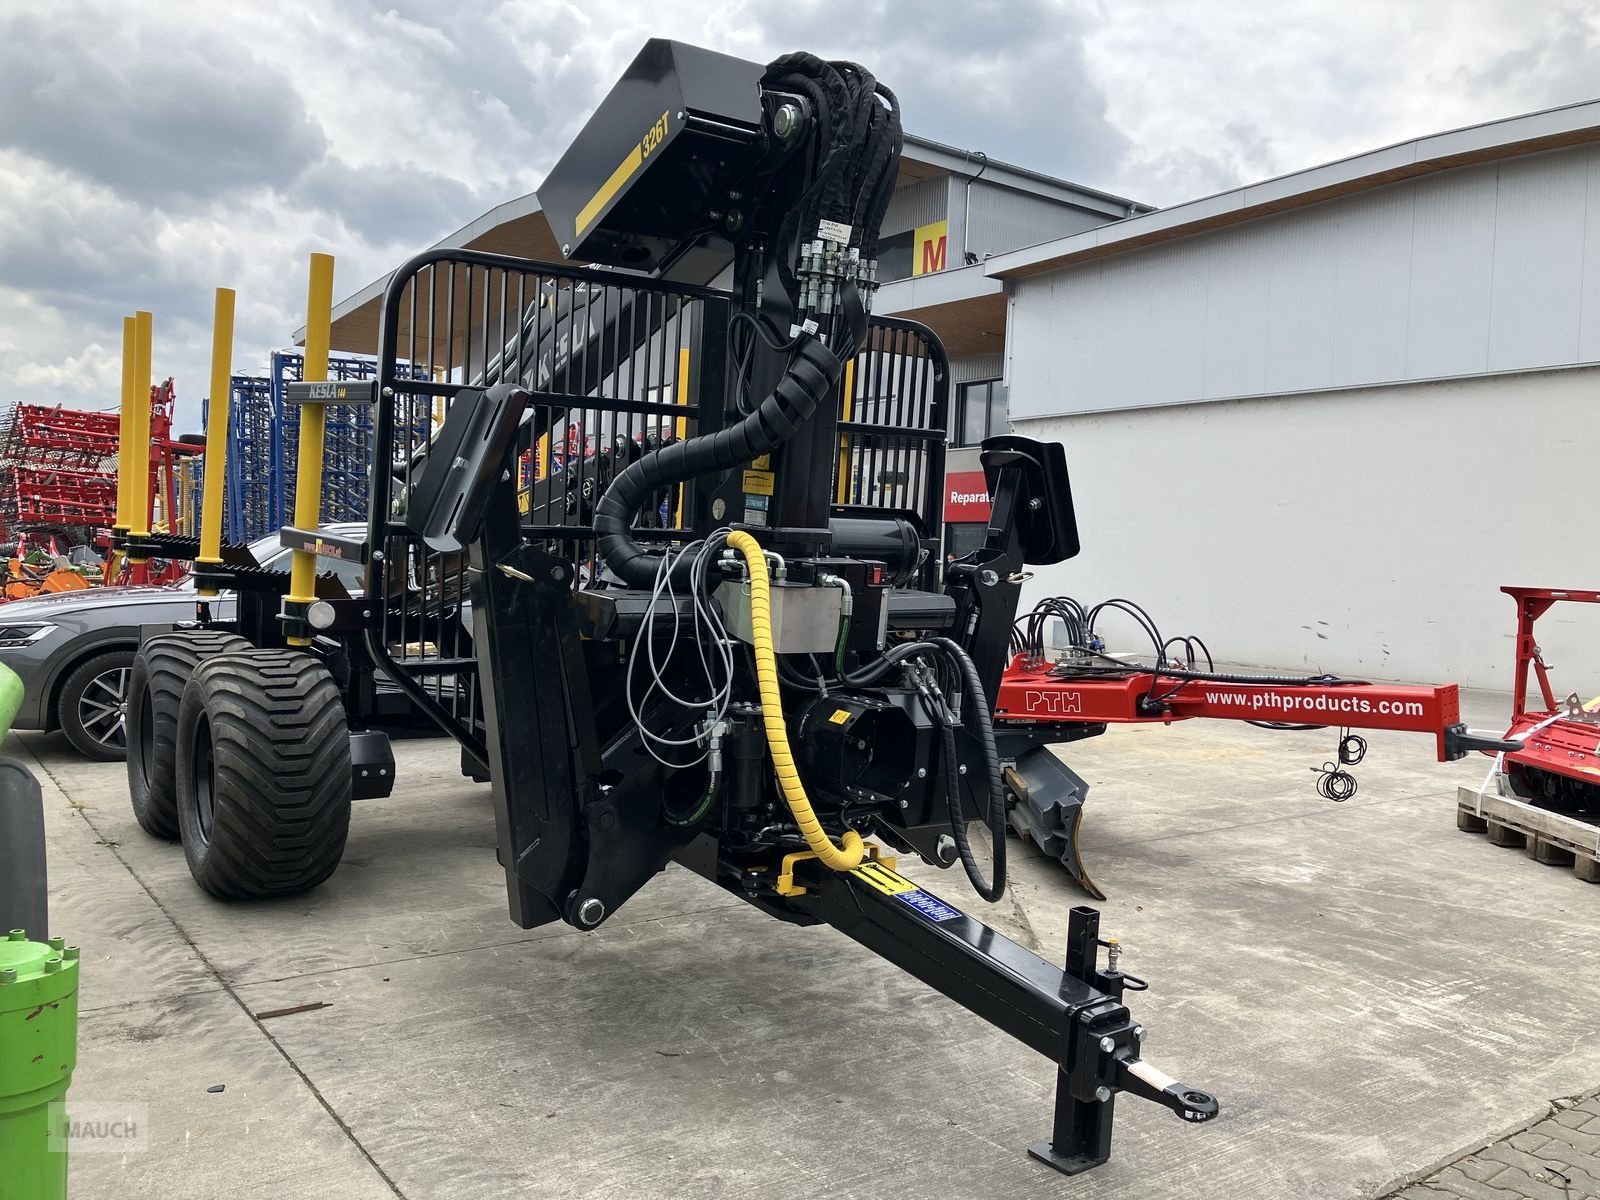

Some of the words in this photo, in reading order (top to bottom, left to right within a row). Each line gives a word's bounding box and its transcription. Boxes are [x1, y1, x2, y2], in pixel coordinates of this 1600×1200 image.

[642, 109, 670, 159] 326T
[922, 235, 947, 274] M
[309, 383, 337, 399] KESLA
[1025, 690, 1081, 713] PTH
[1205, 692, 1424, 716] www.pthproducts.com
